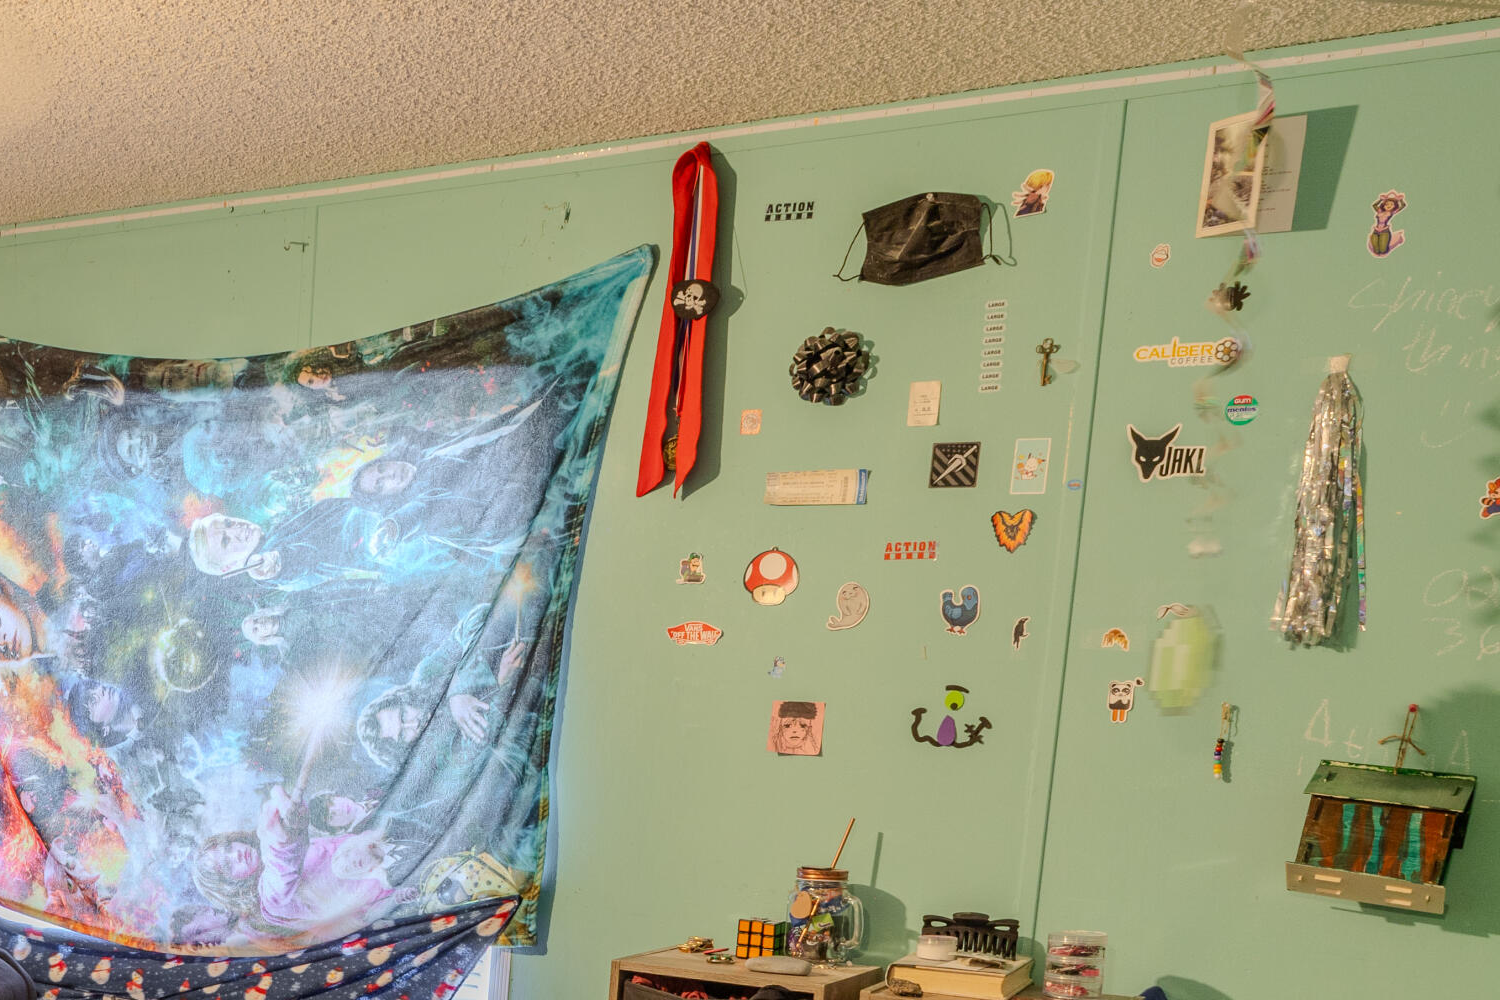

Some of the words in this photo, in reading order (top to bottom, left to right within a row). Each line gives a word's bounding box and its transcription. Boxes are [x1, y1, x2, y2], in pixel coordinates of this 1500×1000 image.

[766, 201, 814, 213] ACTION
[1136, 339, 1213, 360] CALIBER
[1170, 356, 1214, 365] COFFEE
[1159, 447, 1205, 477] JAKL
[885, 541, 936, 553] ACTION
[686, 631, 700, 641] THE
